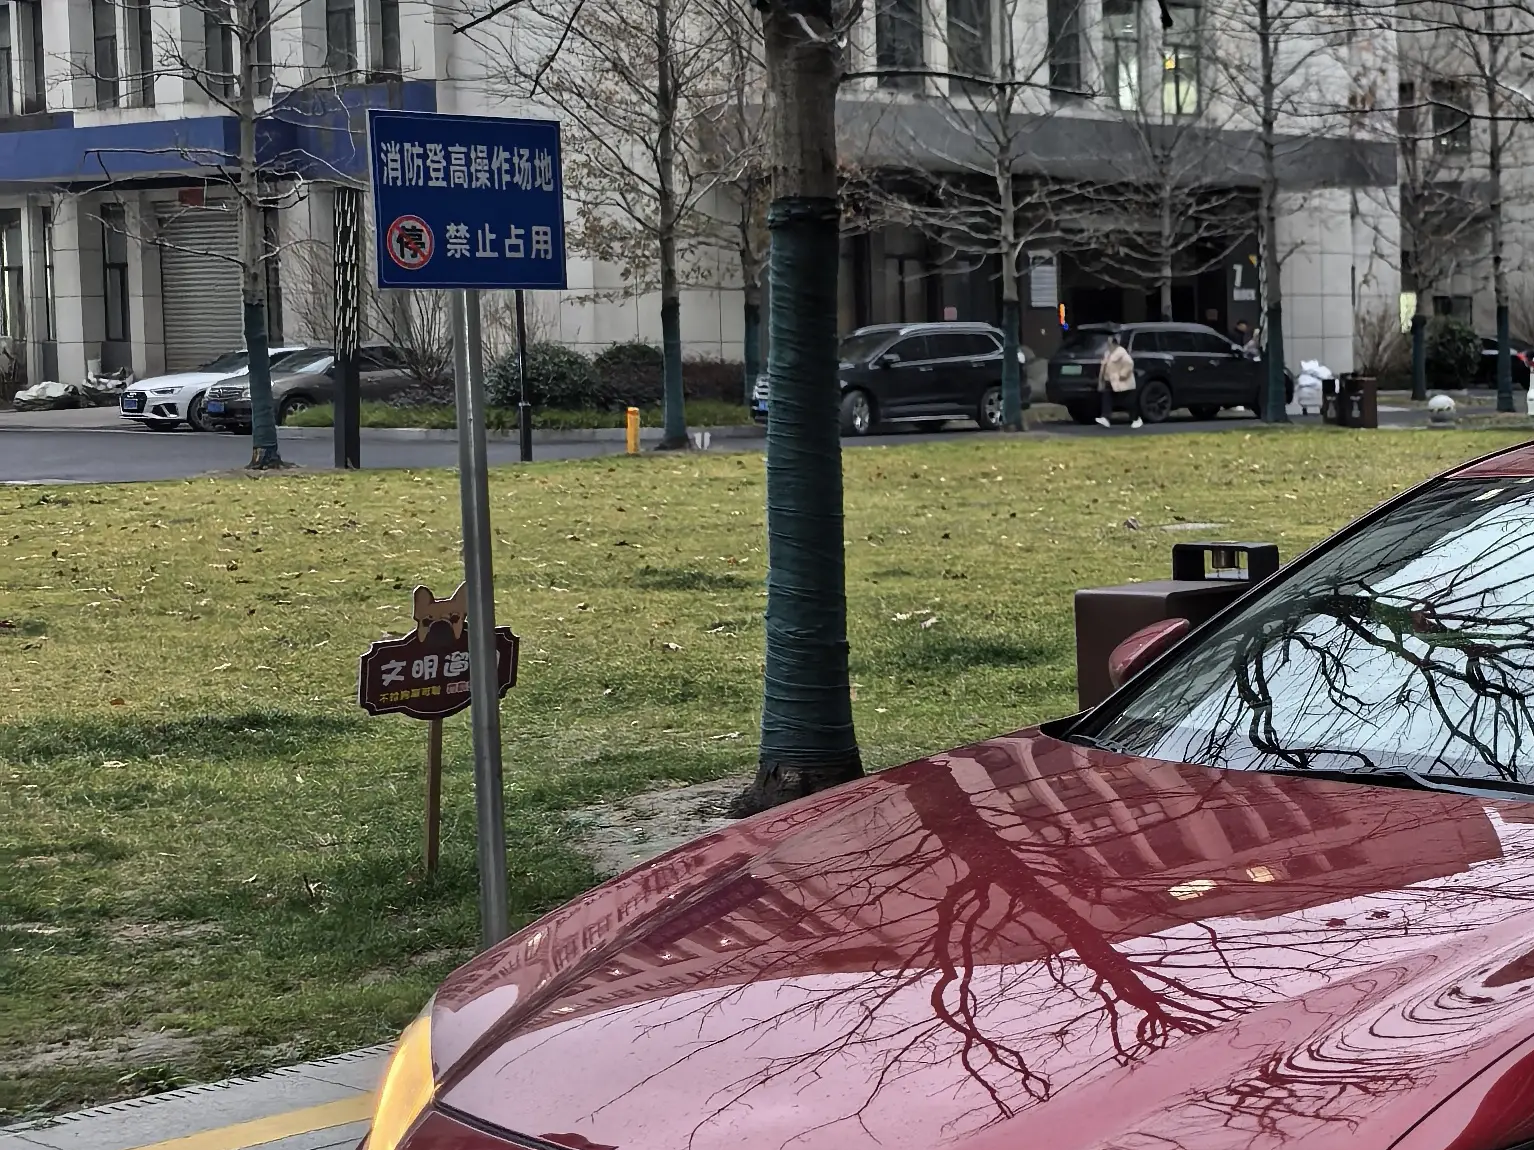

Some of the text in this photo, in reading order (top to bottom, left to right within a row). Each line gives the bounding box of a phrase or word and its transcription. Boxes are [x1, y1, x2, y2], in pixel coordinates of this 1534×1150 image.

[380, 140, 554, 192] 消防登高操作场地
[445, 222, 553, 260] 禁止占用
[380, 649, 500, 686] 文明遛
